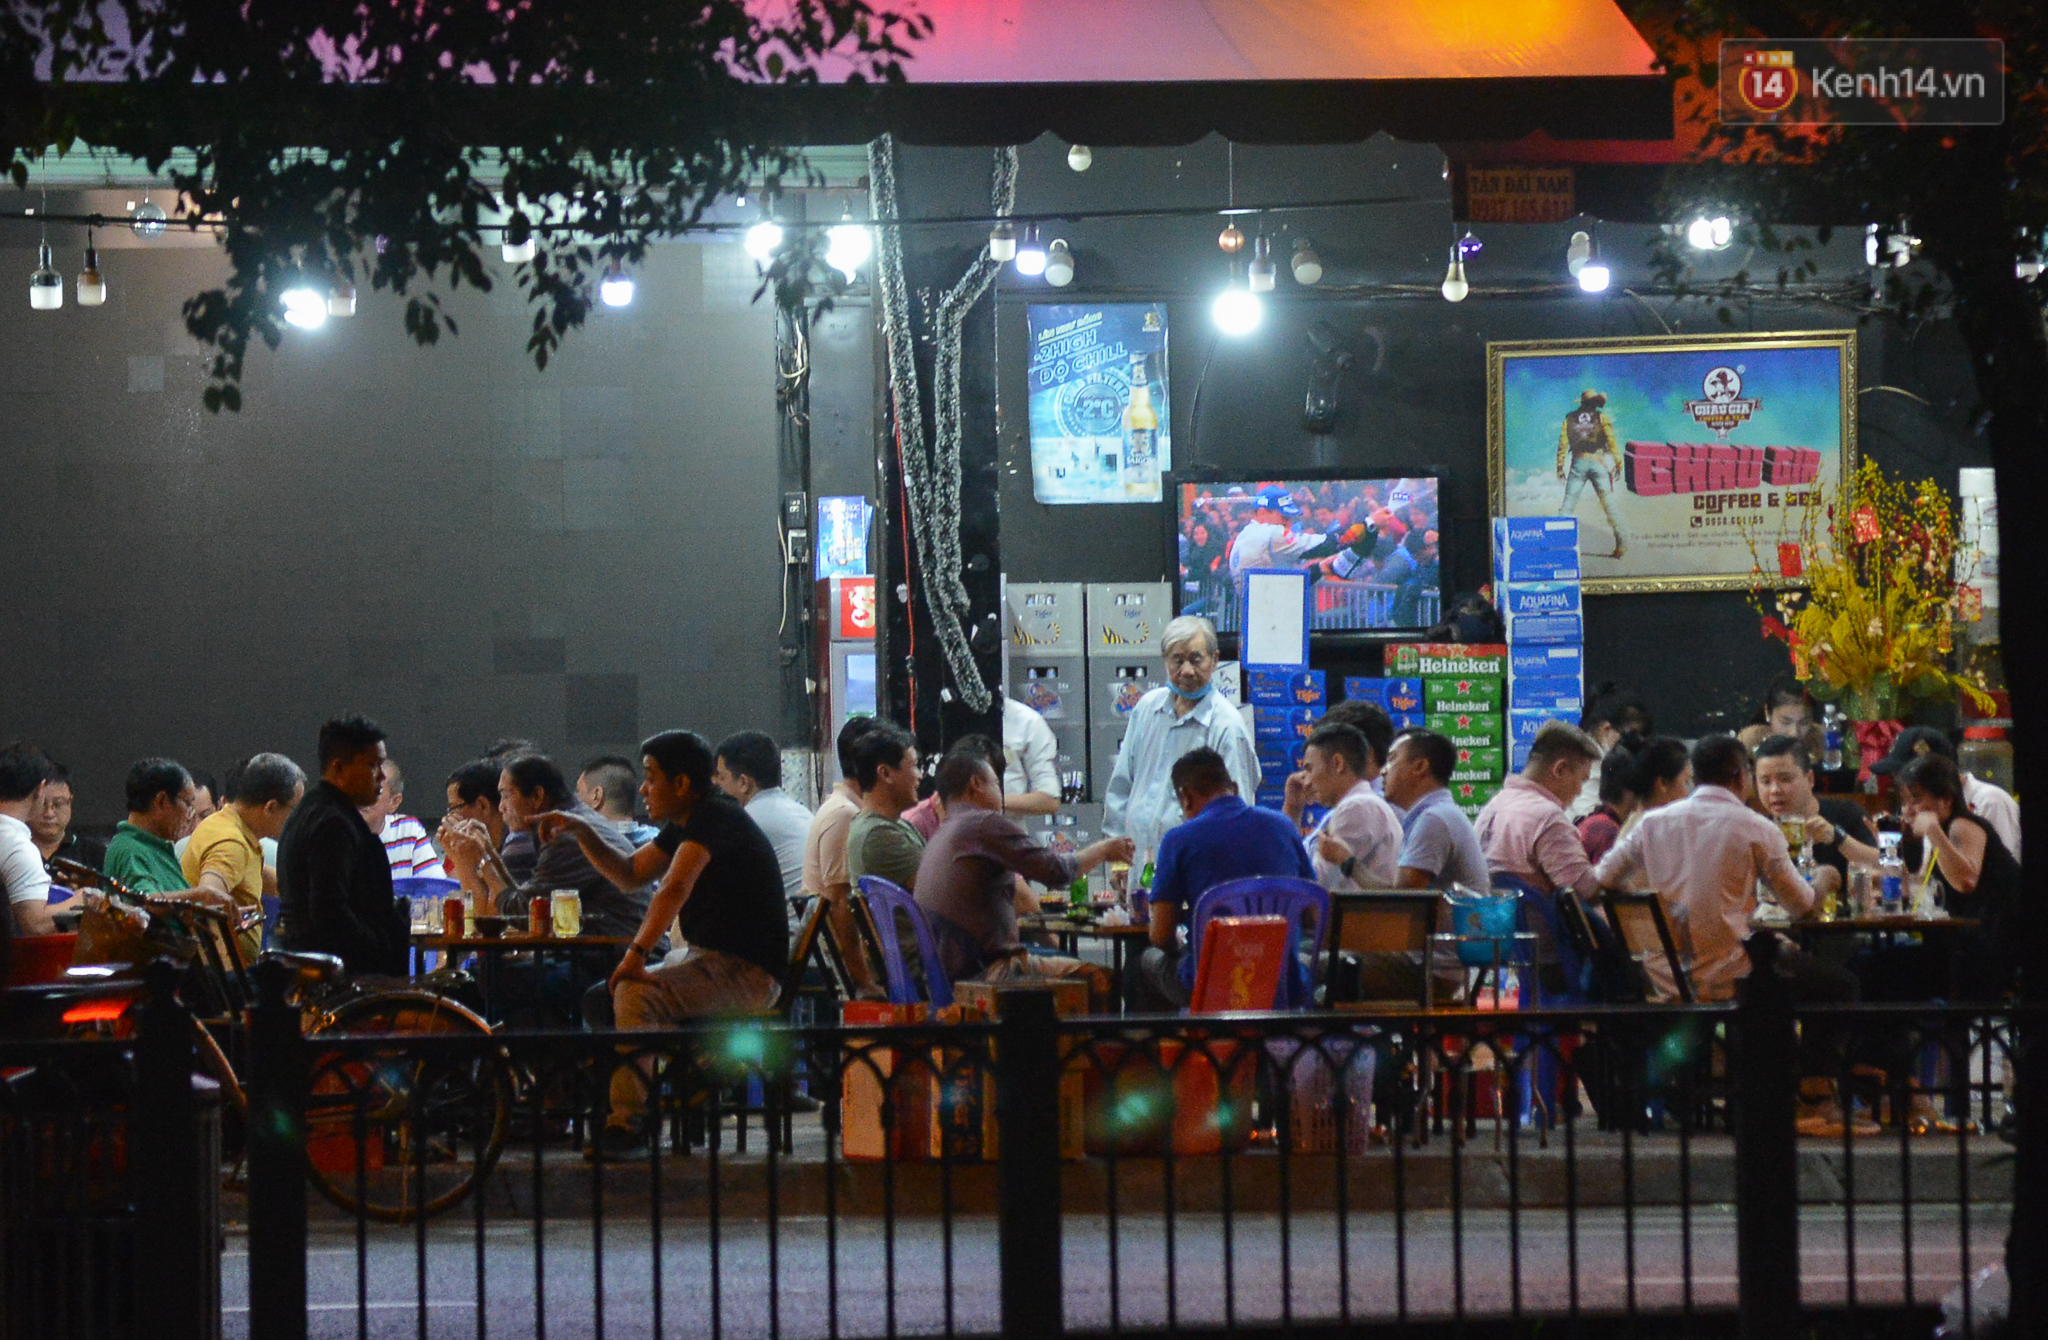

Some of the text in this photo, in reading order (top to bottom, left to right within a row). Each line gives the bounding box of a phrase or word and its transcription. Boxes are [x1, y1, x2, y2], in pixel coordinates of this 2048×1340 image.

[1072, 341, 1128, 373] CHILL
[1767, 492, 1780, 508] &
[1520, 593, 1569, 609] AQUAFINA
[1419, 657, 1501, 674] Heineken
[1296, 689, 1321, 703] Tiger
[1391, 696, 1417, 711] Tiger
[1436, 700, 1490, 712] Heineken
